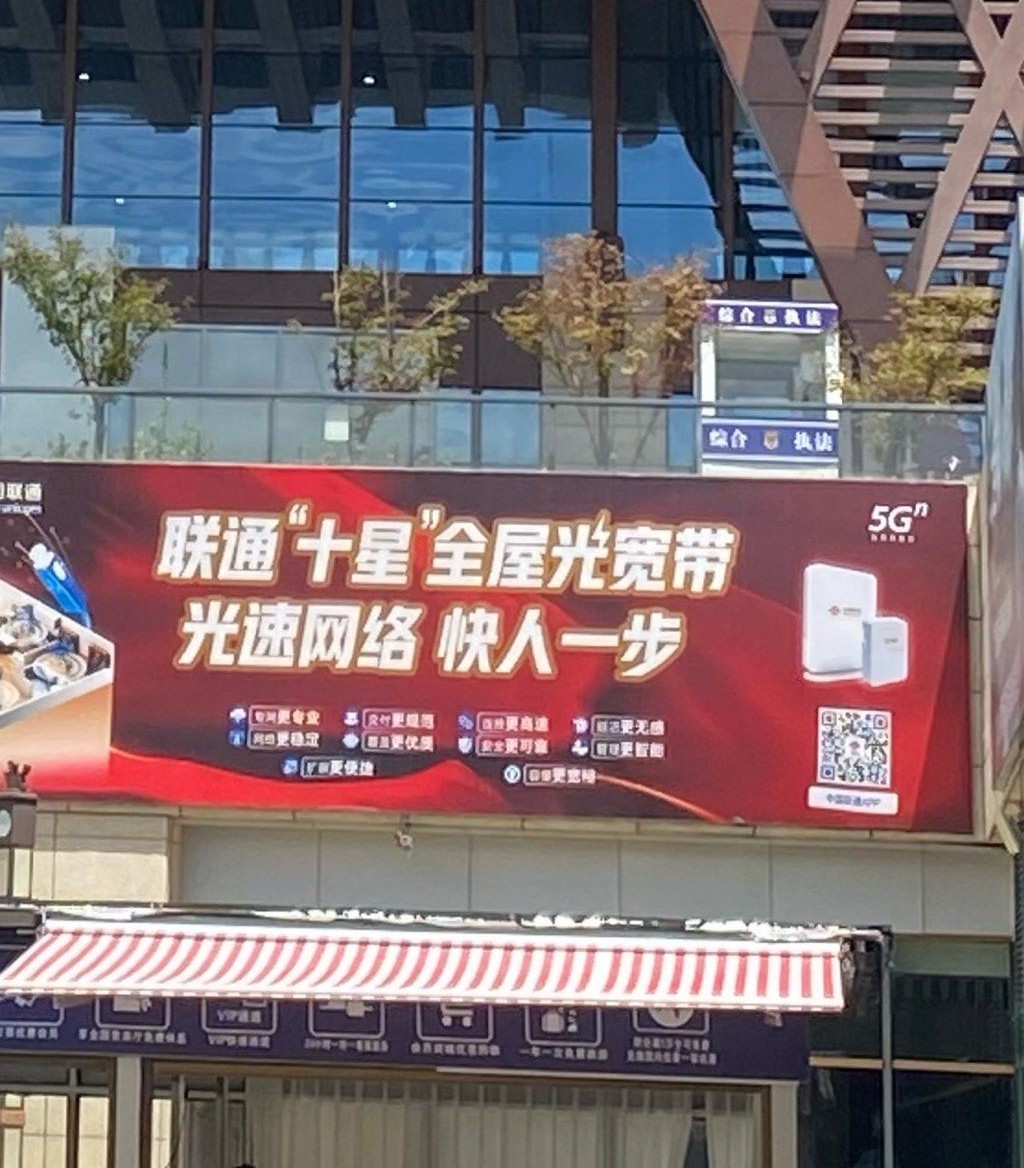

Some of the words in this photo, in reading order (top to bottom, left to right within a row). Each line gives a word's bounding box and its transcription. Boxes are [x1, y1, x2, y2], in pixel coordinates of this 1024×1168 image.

[717, 306, 755, 324] 综合
[784, 308, 823, 326] 执法
[708, 428, 748, 448] 综合
[793, 430, 834, 452] 执法
[179, 598, 423, 670] 光速网络
[437, 606, 684, 679] 快人一步
